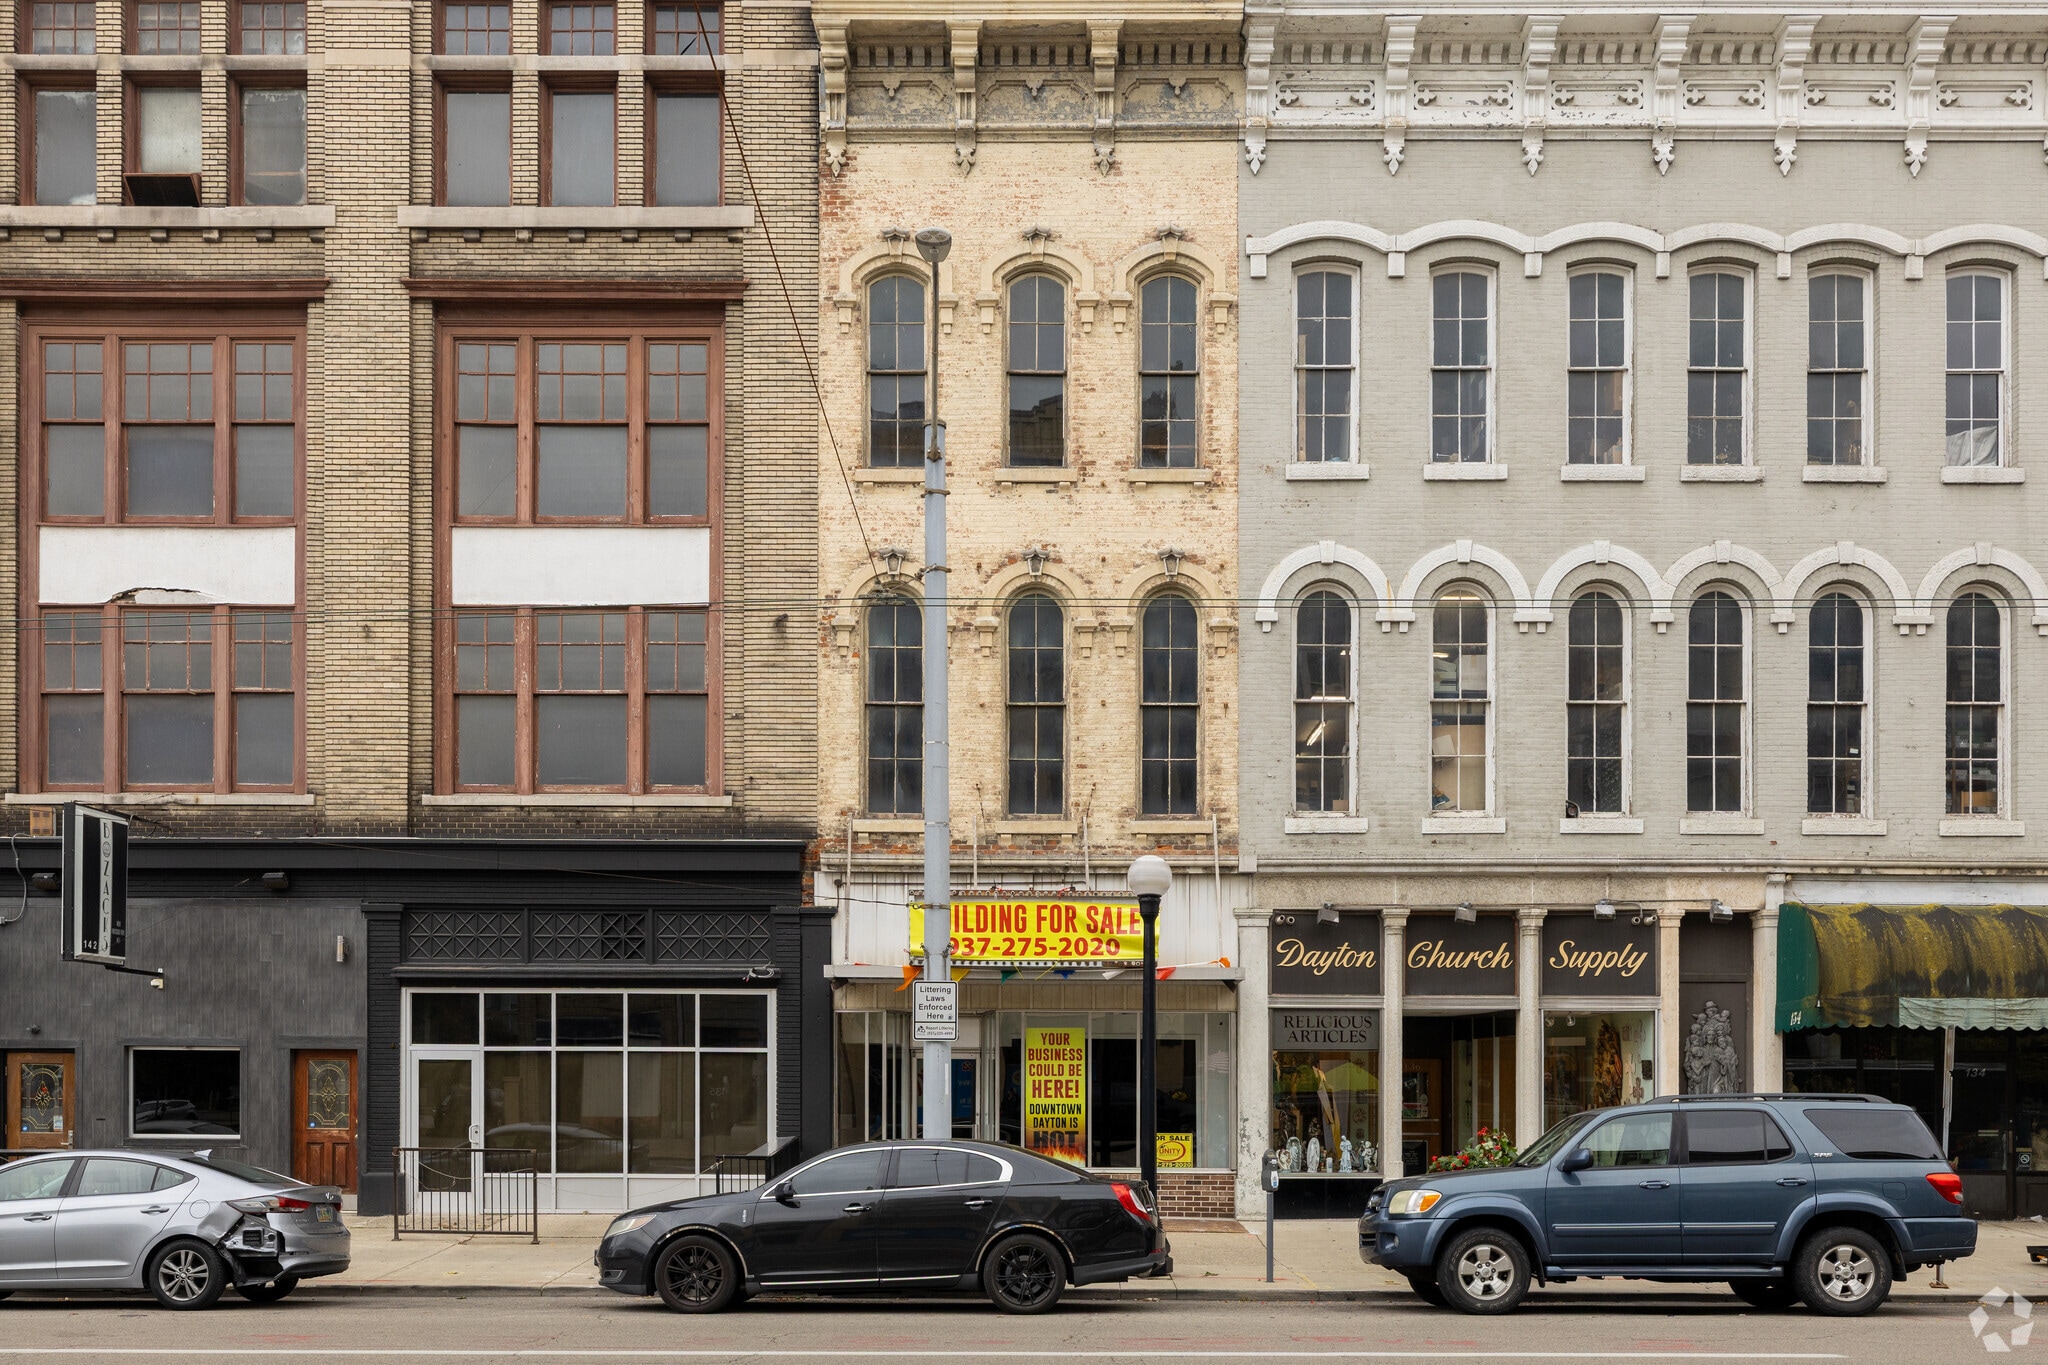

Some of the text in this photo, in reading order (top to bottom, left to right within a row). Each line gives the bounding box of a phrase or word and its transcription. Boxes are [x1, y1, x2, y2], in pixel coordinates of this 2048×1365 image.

[950, 904, 1141, 935] ILDING FOR SALE
[83, 939, 98, 950] 142
[950, 937, 1121, 957] 937-275-2020
[1276, 938, 1649, 977] Dayton Church Supply
[920, 986, 951, 994] Littering
[1284, 1015, 1373, 1029] RELIGIOUS
[1040, 1032, 1071, 1046] YOUR
[1287, 1029, 1367, 1043] ARTICLES
[1027, 1048, 1083, 1061] BUSINESS
[1028, 1063, 1083, 1077] COULD BE
[1965, 1067, 1986, 1078] 134
[1031, 1079, 1080, 1098] HERE!
[1029, 1103, 1082, 1115] DOWNTOWN
[1033, 1117, 1079, 1128] DAYTON IS
[1033, 1130, 1079, 1149] HOT
